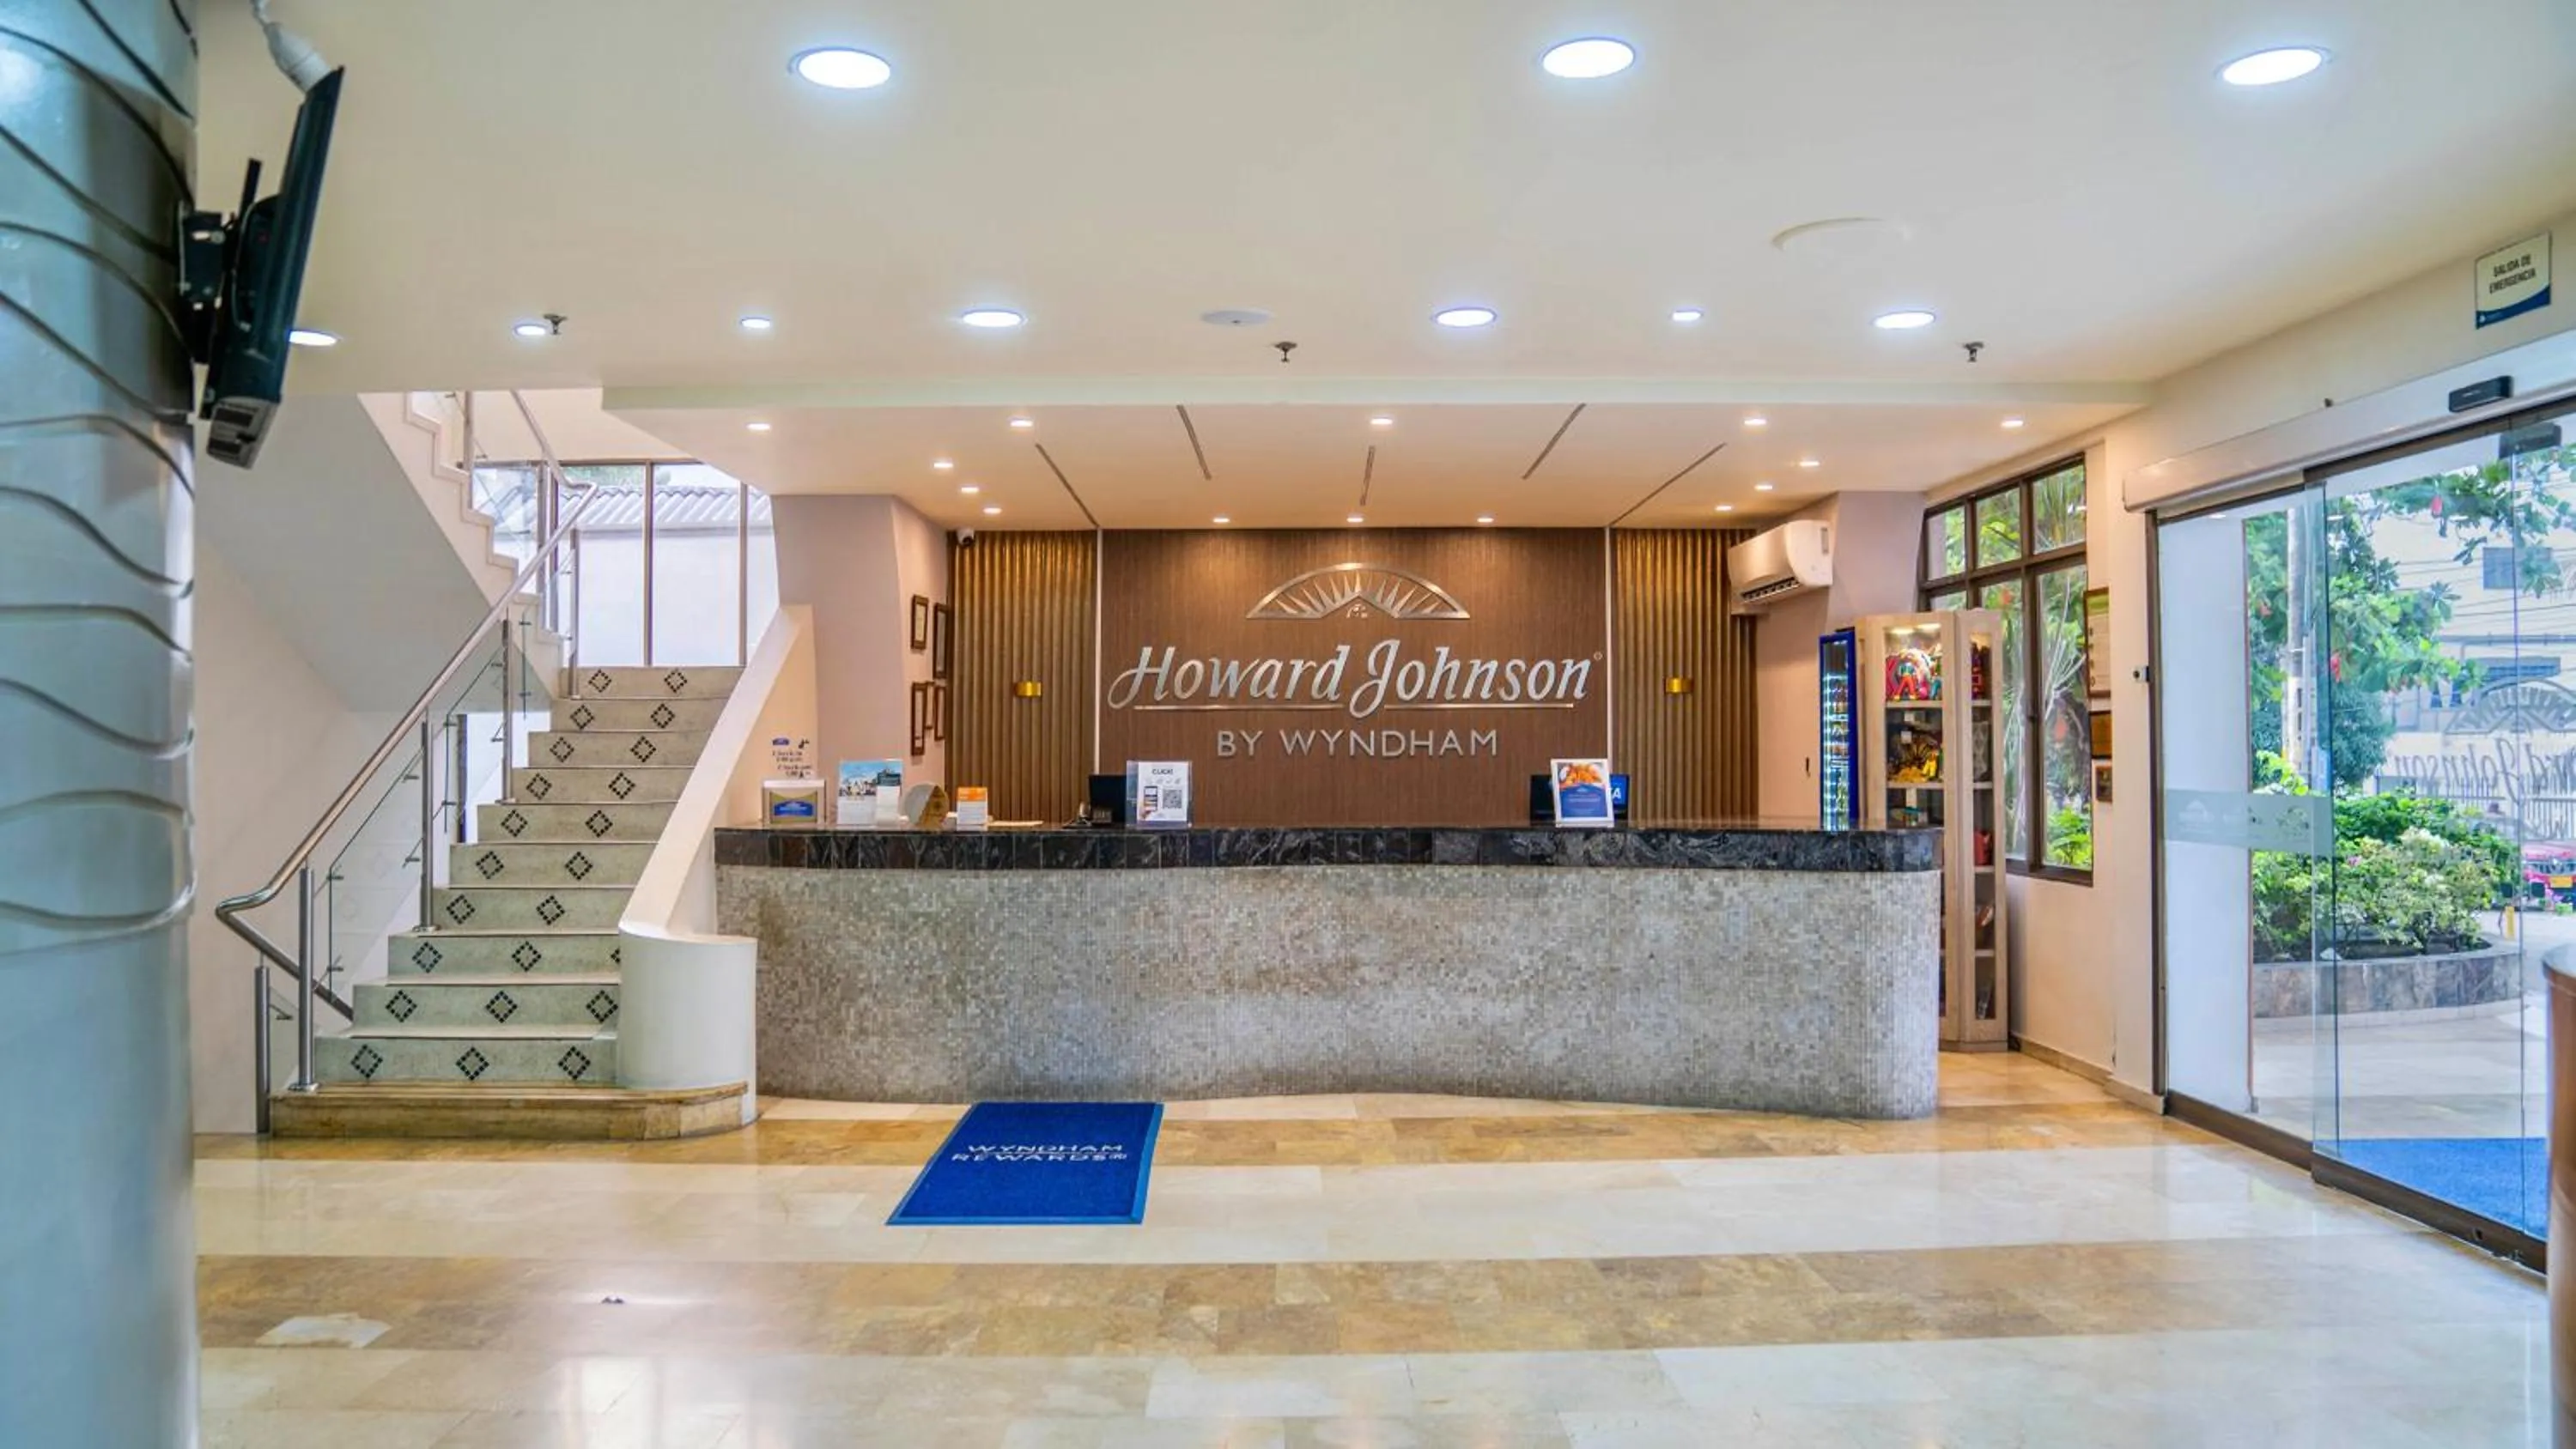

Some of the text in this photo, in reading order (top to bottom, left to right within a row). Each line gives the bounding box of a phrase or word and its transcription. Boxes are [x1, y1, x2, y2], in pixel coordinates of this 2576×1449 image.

[1108, 646, 1351, 709] Howard
[1218, 730, 1498, 757] BY WYNDHAM
